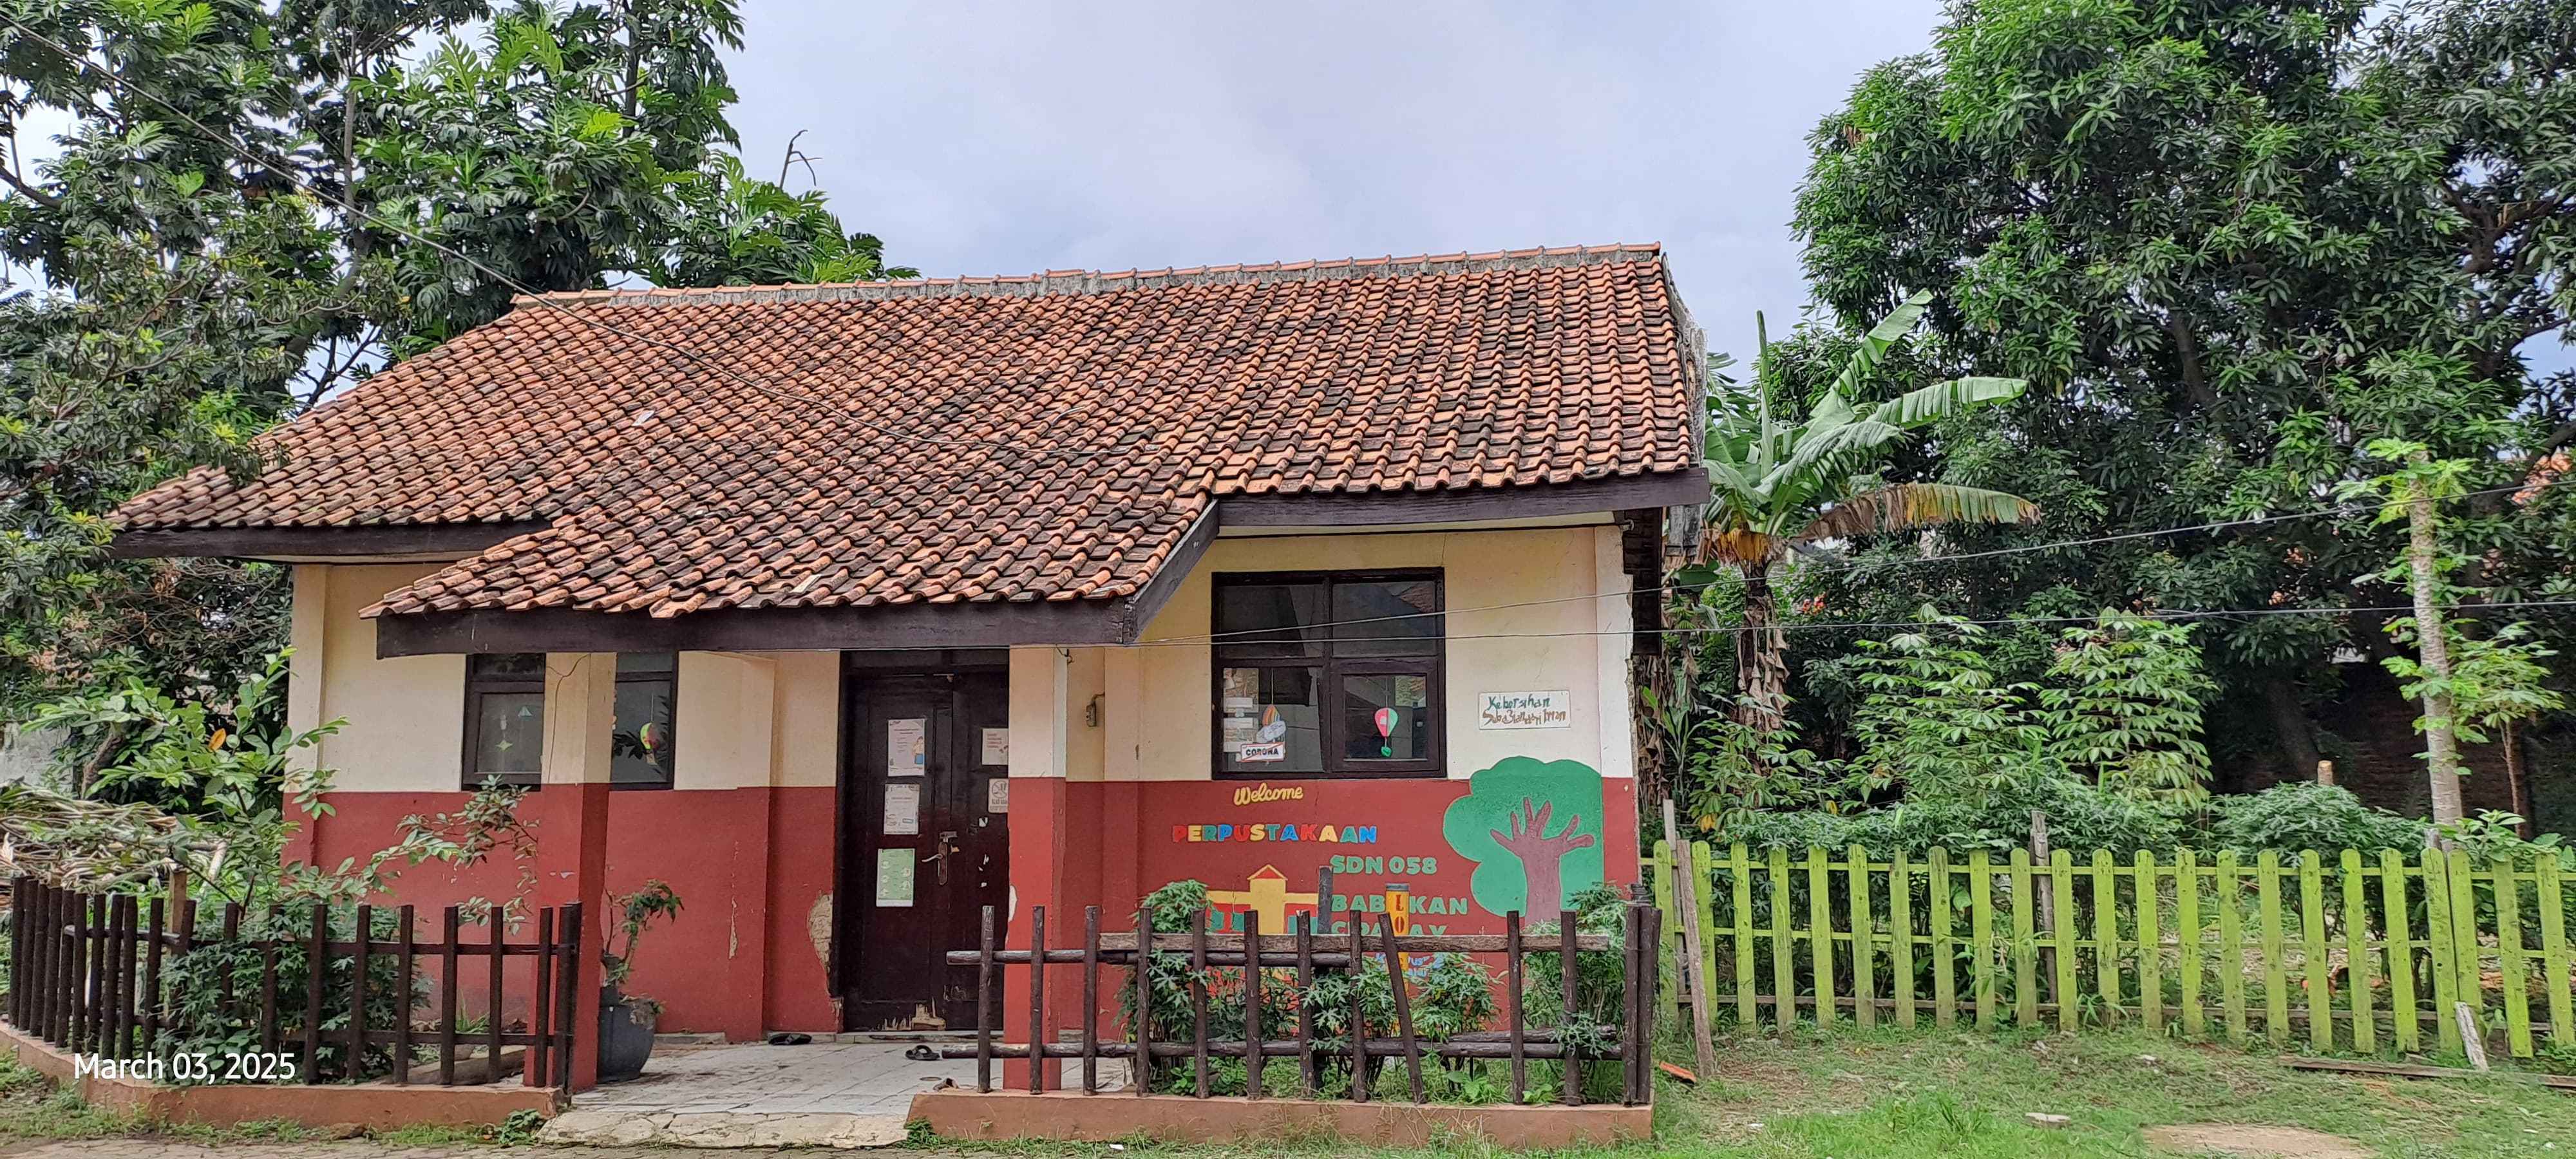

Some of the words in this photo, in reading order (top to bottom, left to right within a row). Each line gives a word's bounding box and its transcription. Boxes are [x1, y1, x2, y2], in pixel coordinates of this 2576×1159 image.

[1245, 748, 1279, 756] CORONA
[1233, 782, 1304, 806] Welcome
[1172, 824, 1378, 844] PERPUSTAKAAN
[1330, 854, 1383, 875] SDN
[1388, 856, 1437, 875] 058
[1331, 894, 1468, 915] BABKAN
